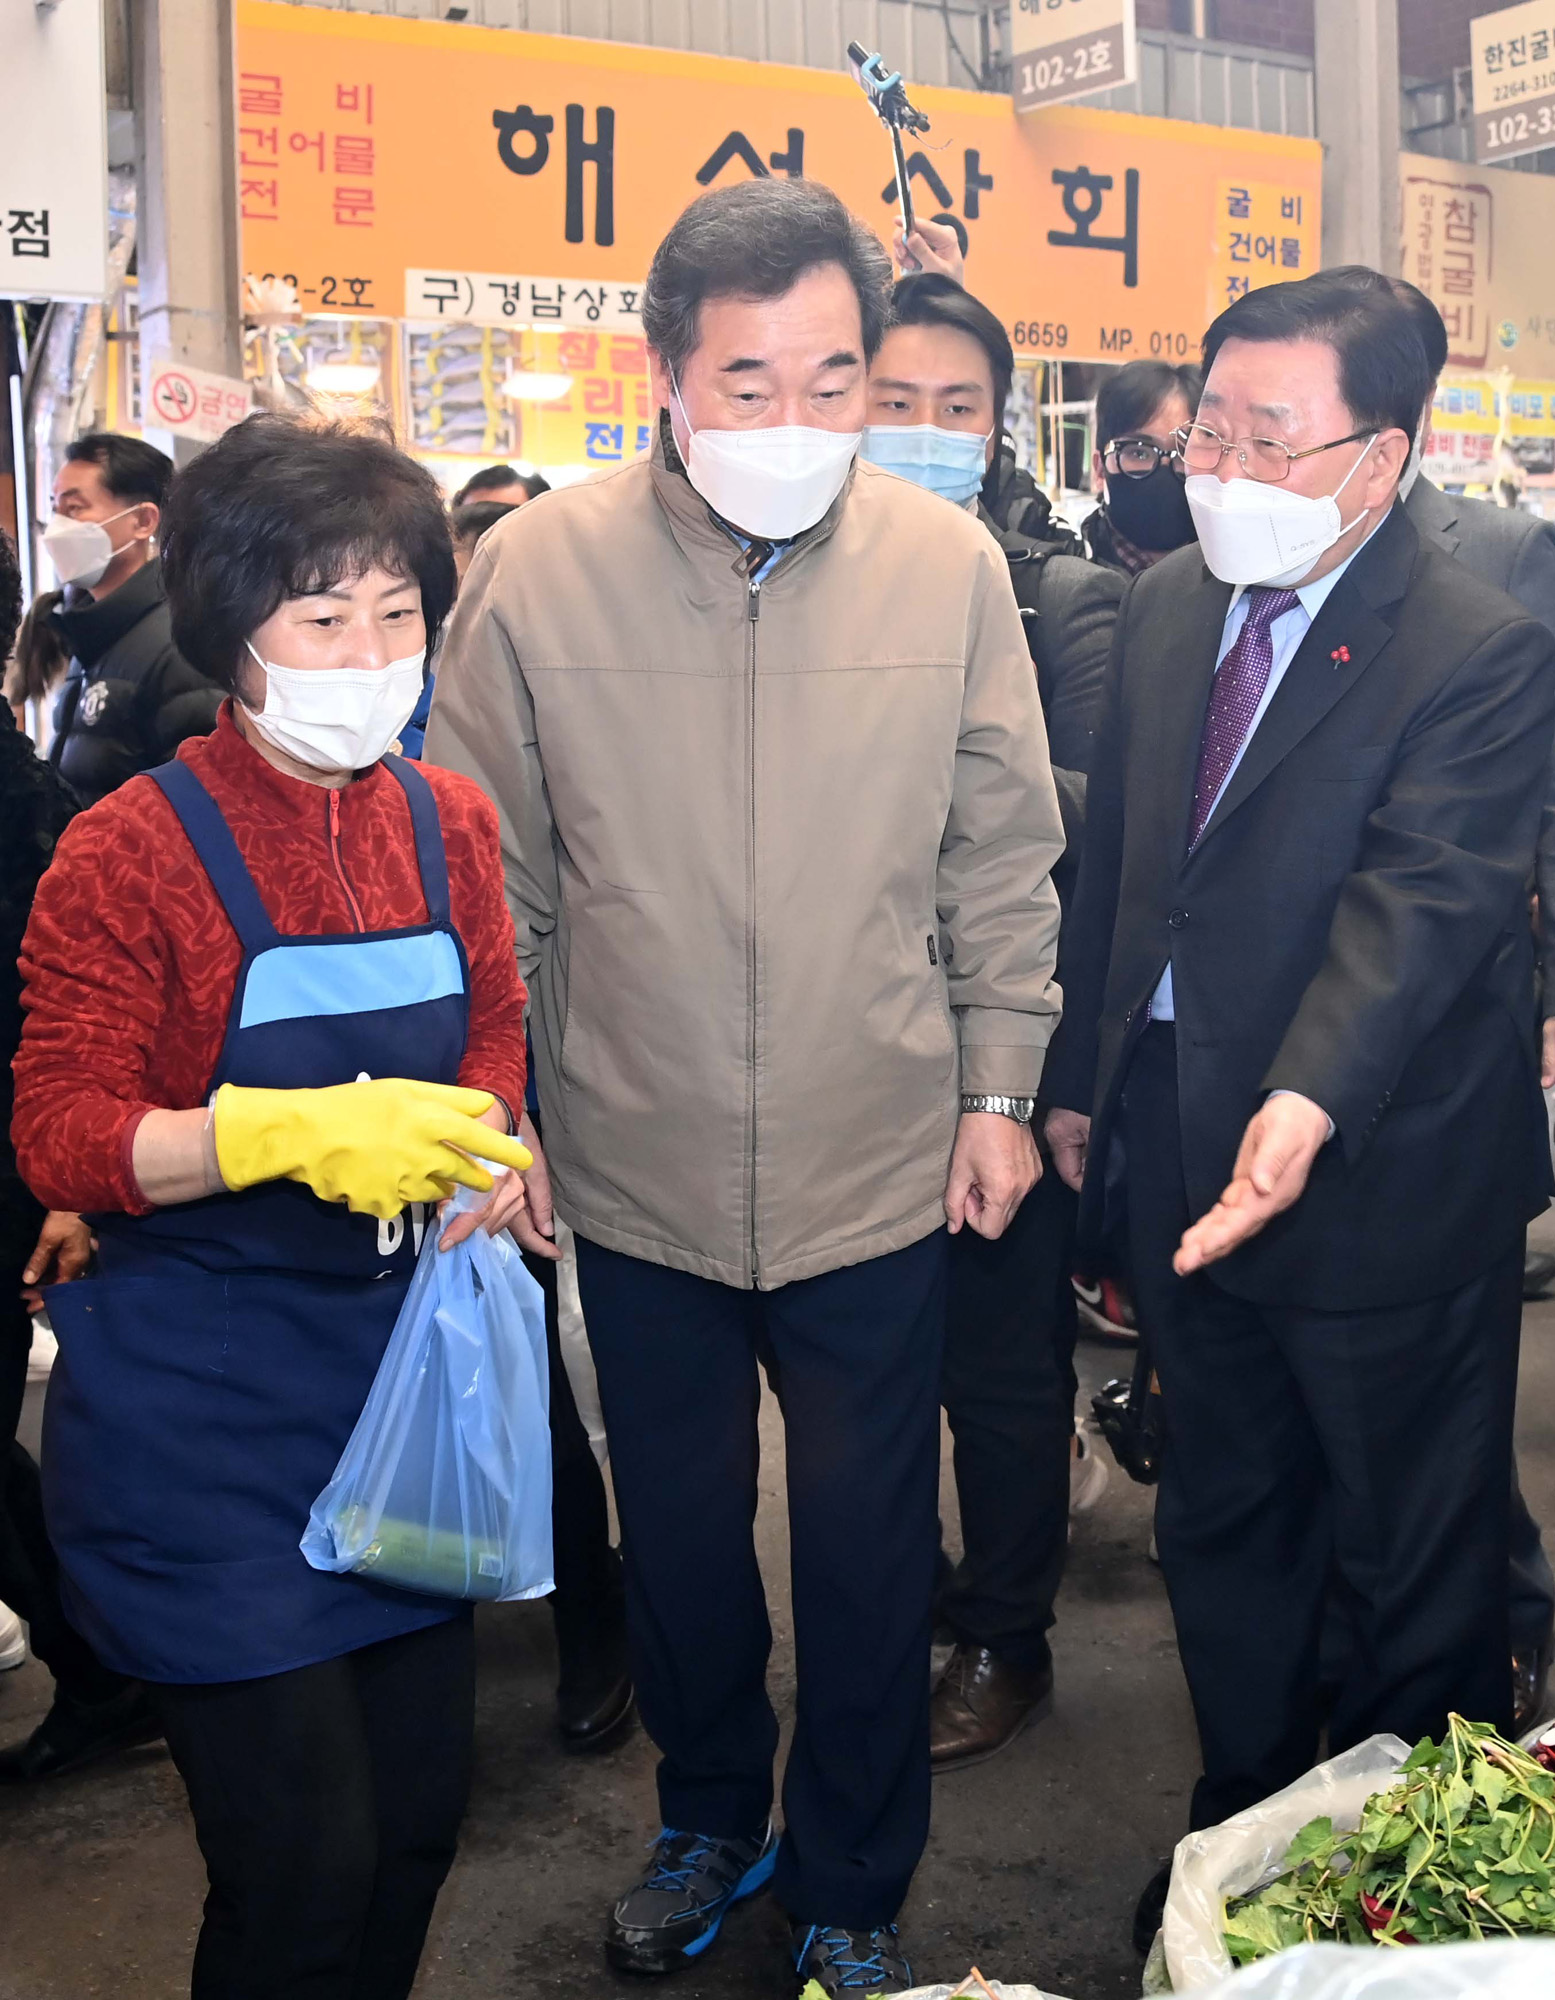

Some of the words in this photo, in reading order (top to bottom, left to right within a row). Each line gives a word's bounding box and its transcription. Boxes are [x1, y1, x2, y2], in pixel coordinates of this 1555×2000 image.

[1021, 40, 1114, 95] 102-2호
[1484, 28, 1555, 74] 한진굴
[1486, 104, 1555, 148] 102-3
[239, 127, 375, 176] 건어물
[1229, 232, 1302, 268] 건어물
[422, 277, 474, 315] 구)
[1100, 327, 1138, 353] MP.
